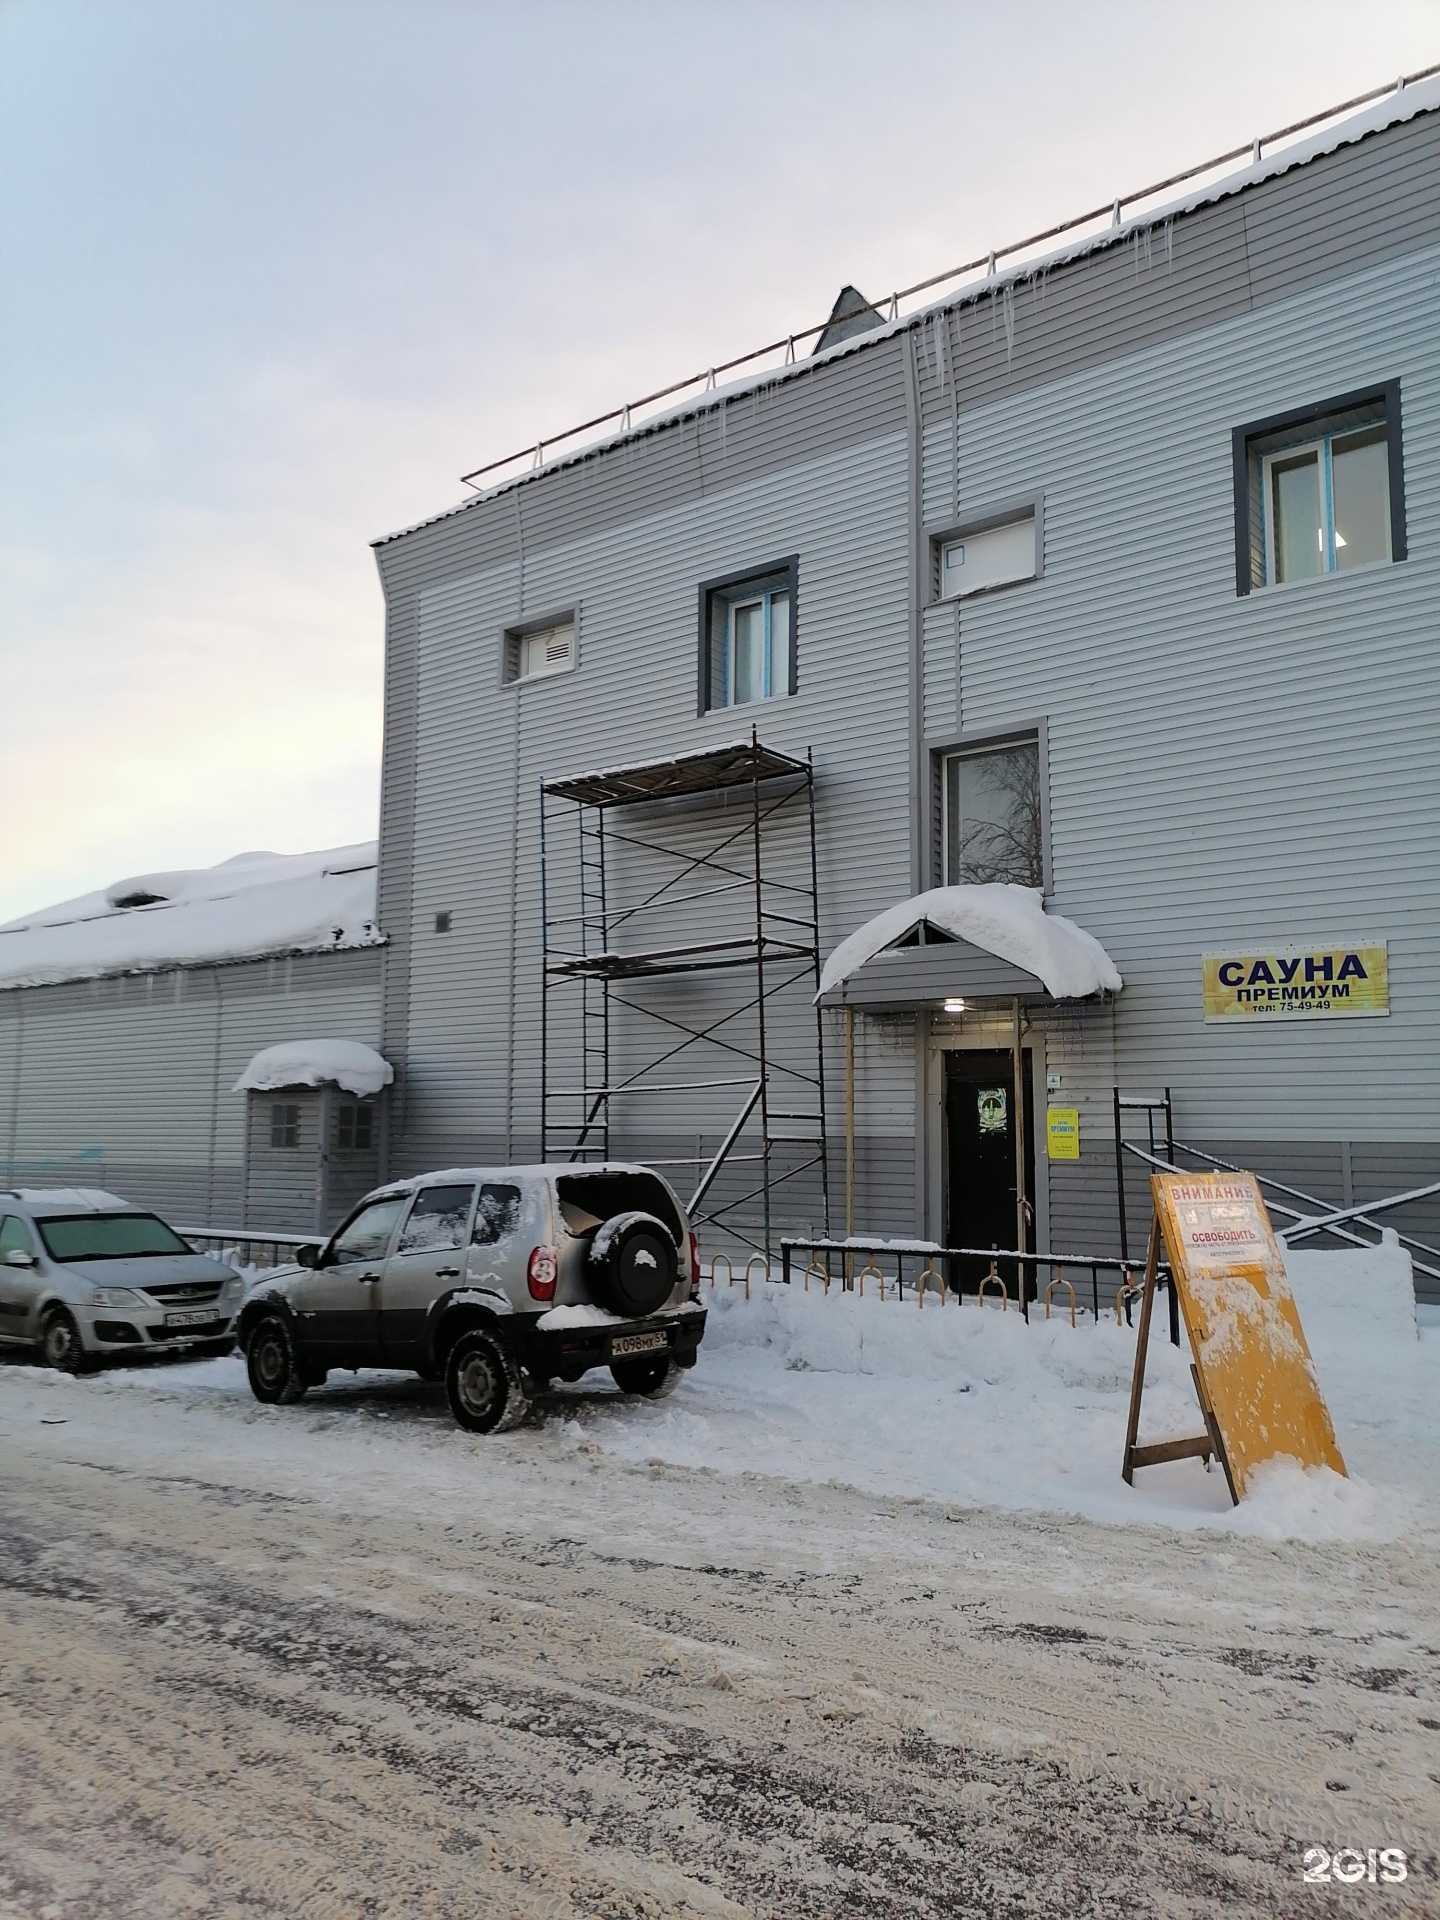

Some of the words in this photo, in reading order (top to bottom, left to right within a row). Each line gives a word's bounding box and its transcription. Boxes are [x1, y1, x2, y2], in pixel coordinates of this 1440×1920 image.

[1218, 954, 1368, 987] САУНА
[1237, 983, 1350, 1002] ПРЕМИУМ
[1252, 1003, 1276, 1013] тел:
[1279, 1000, 1331, 1012] 75-49-49
[1171, 1185, 1253, 1201] ВНИМАНИЕ
[1191, 1230, 1256, 1243] ОСВОБОДИТЬ
